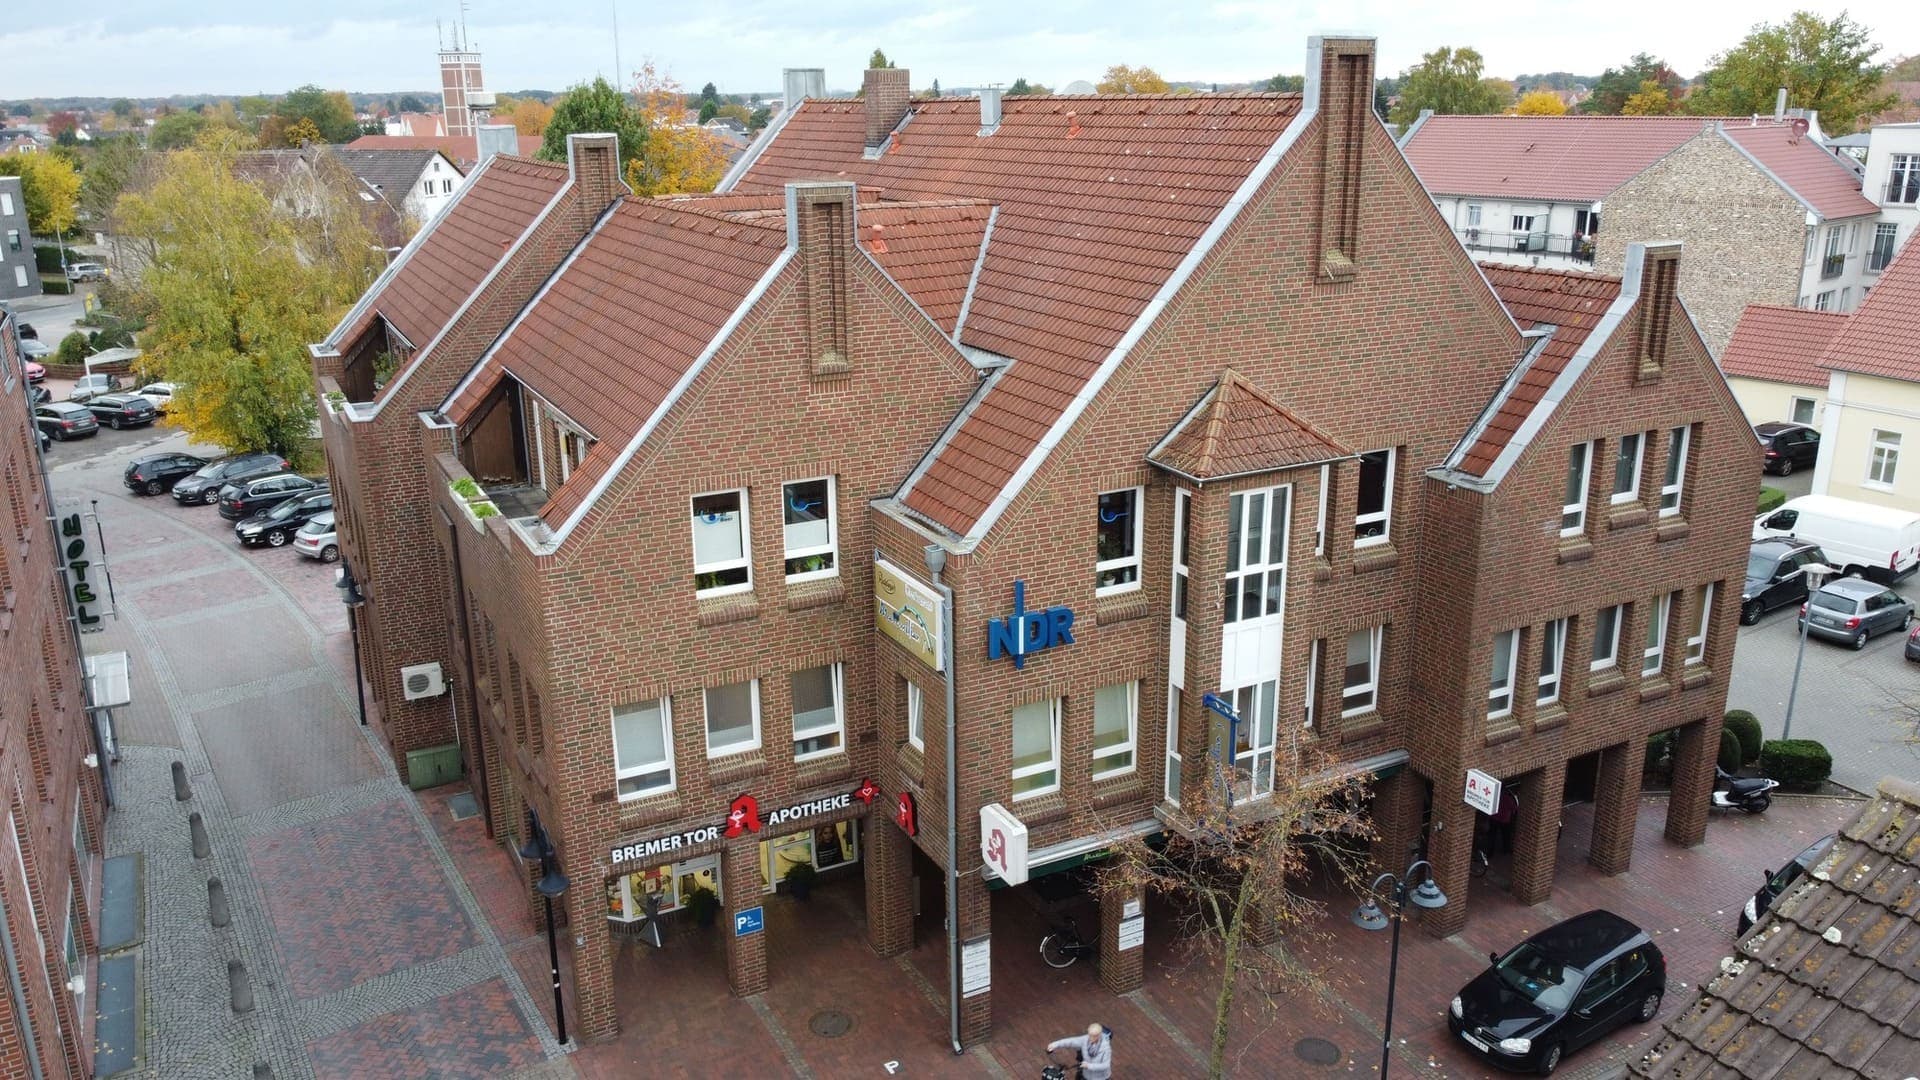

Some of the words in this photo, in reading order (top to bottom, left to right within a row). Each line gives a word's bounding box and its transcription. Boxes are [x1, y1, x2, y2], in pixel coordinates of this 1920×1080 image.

[62, 513, 100, 625] HOTEL
[988, 604, 1076, 663] NDR
[768, 794, 850, 826] APOTHEKE
[611, 835, 682, 864] BREMER
[684, 826, 718, 846] TOR
[737, 917, 746, 930] P
